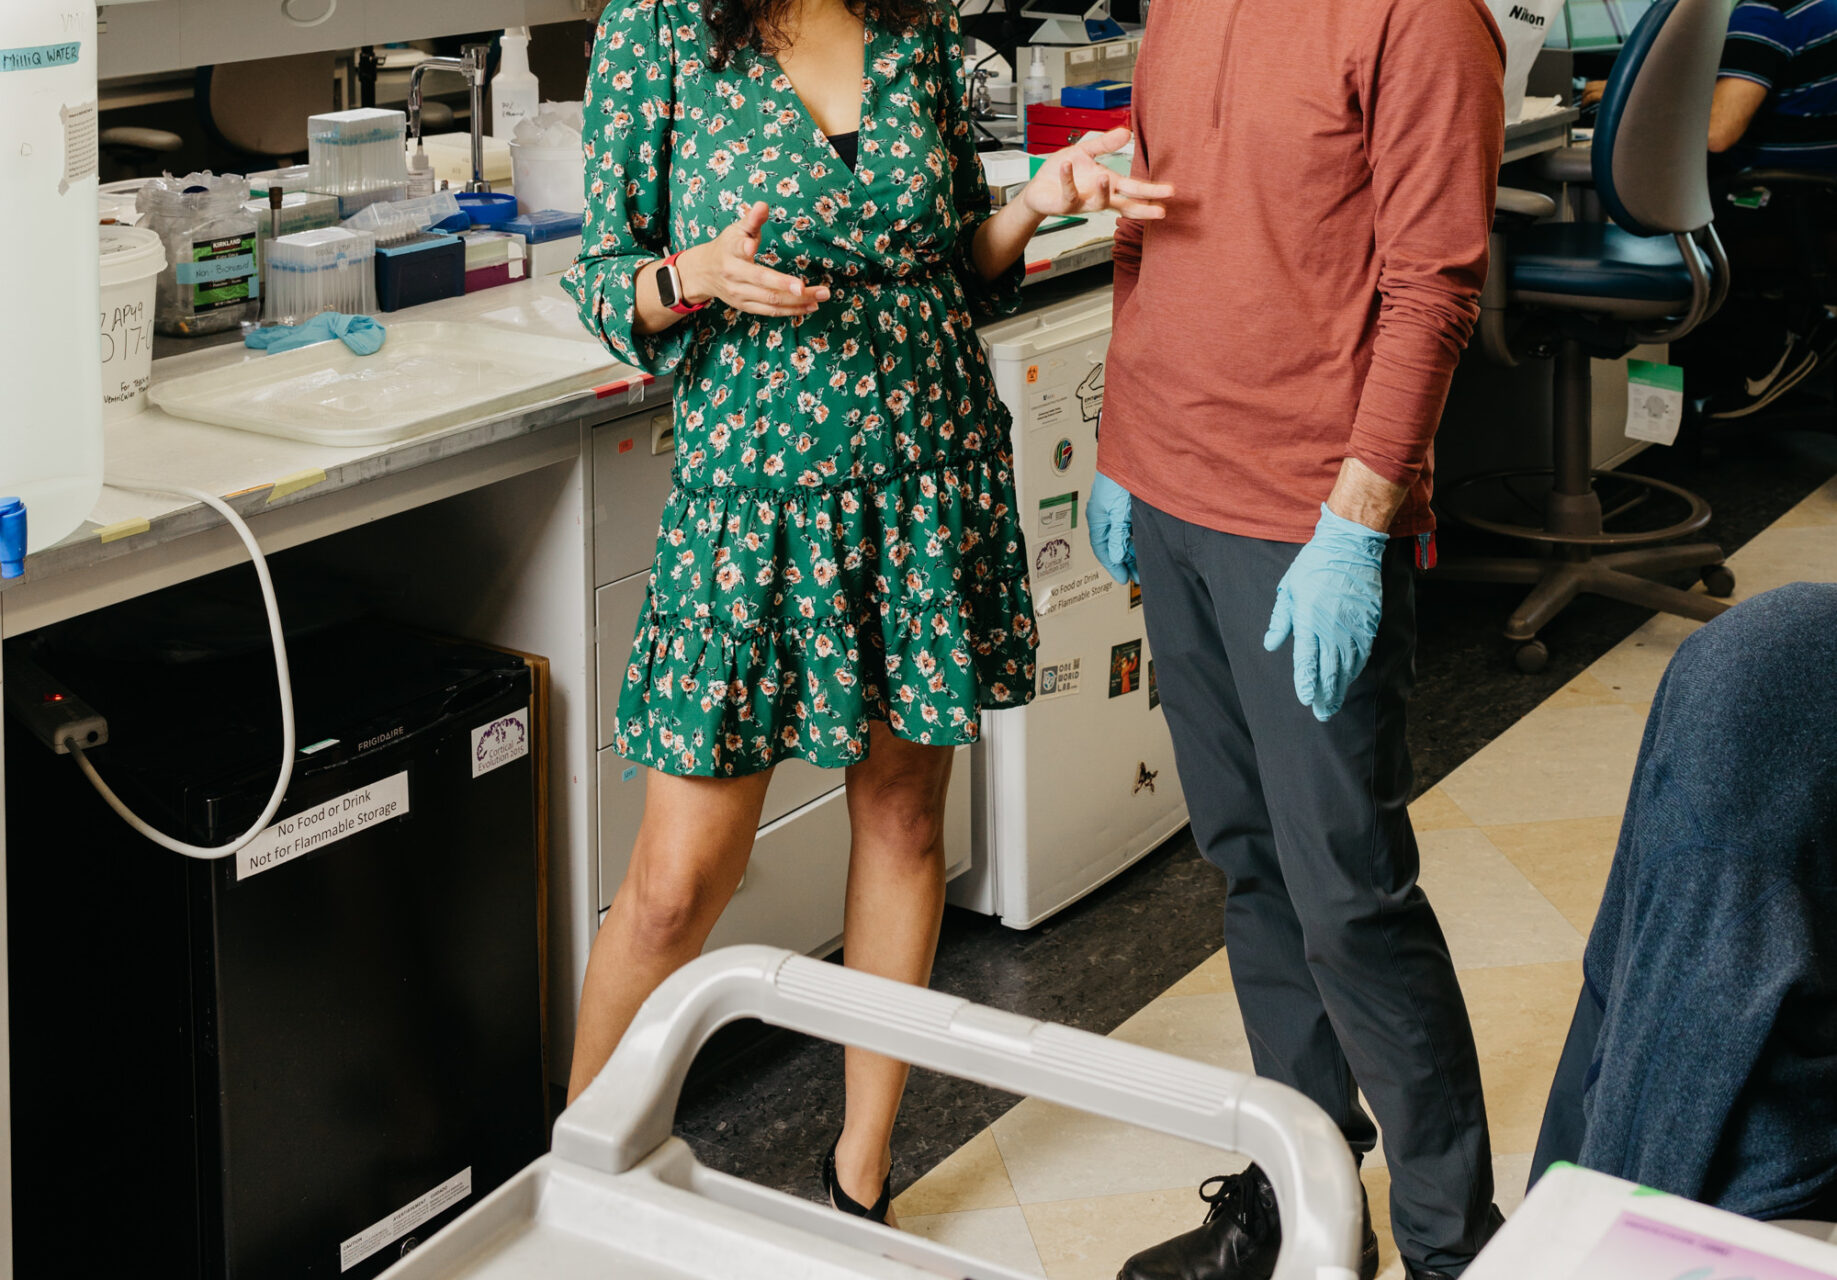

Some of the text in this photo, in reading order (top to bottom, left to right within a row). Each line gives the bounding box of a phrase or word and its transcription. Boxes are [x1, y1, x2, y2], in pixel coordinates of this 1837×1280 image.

[1509, 5, 1545, 27] Nikon
[3, 46, 78, 70] MilliQ WATER
[212, 238, 242, 249] KIRKLAND
[1060, 579, 1076, 593] Food
[1076, 579, 1083, 588] or
[1084, 571, 1099, 584] Drink
[1058, 590, 1090, 609] Flammable
[1091, 581, 1113, 596] Storage
[1058, 671, 1079, 682] WORLD
[1059, 663, 1072, 672] ONE
[358, 726, 404, 752] FRIGIDAIRE
[489, 740, 514, 759] Cortical
[478, 745, 524, 772] Evolution 2015
[277, 789, 371, 838] No Food or Drink
[250, 800, 397, 870] Not for Flammable Storage
